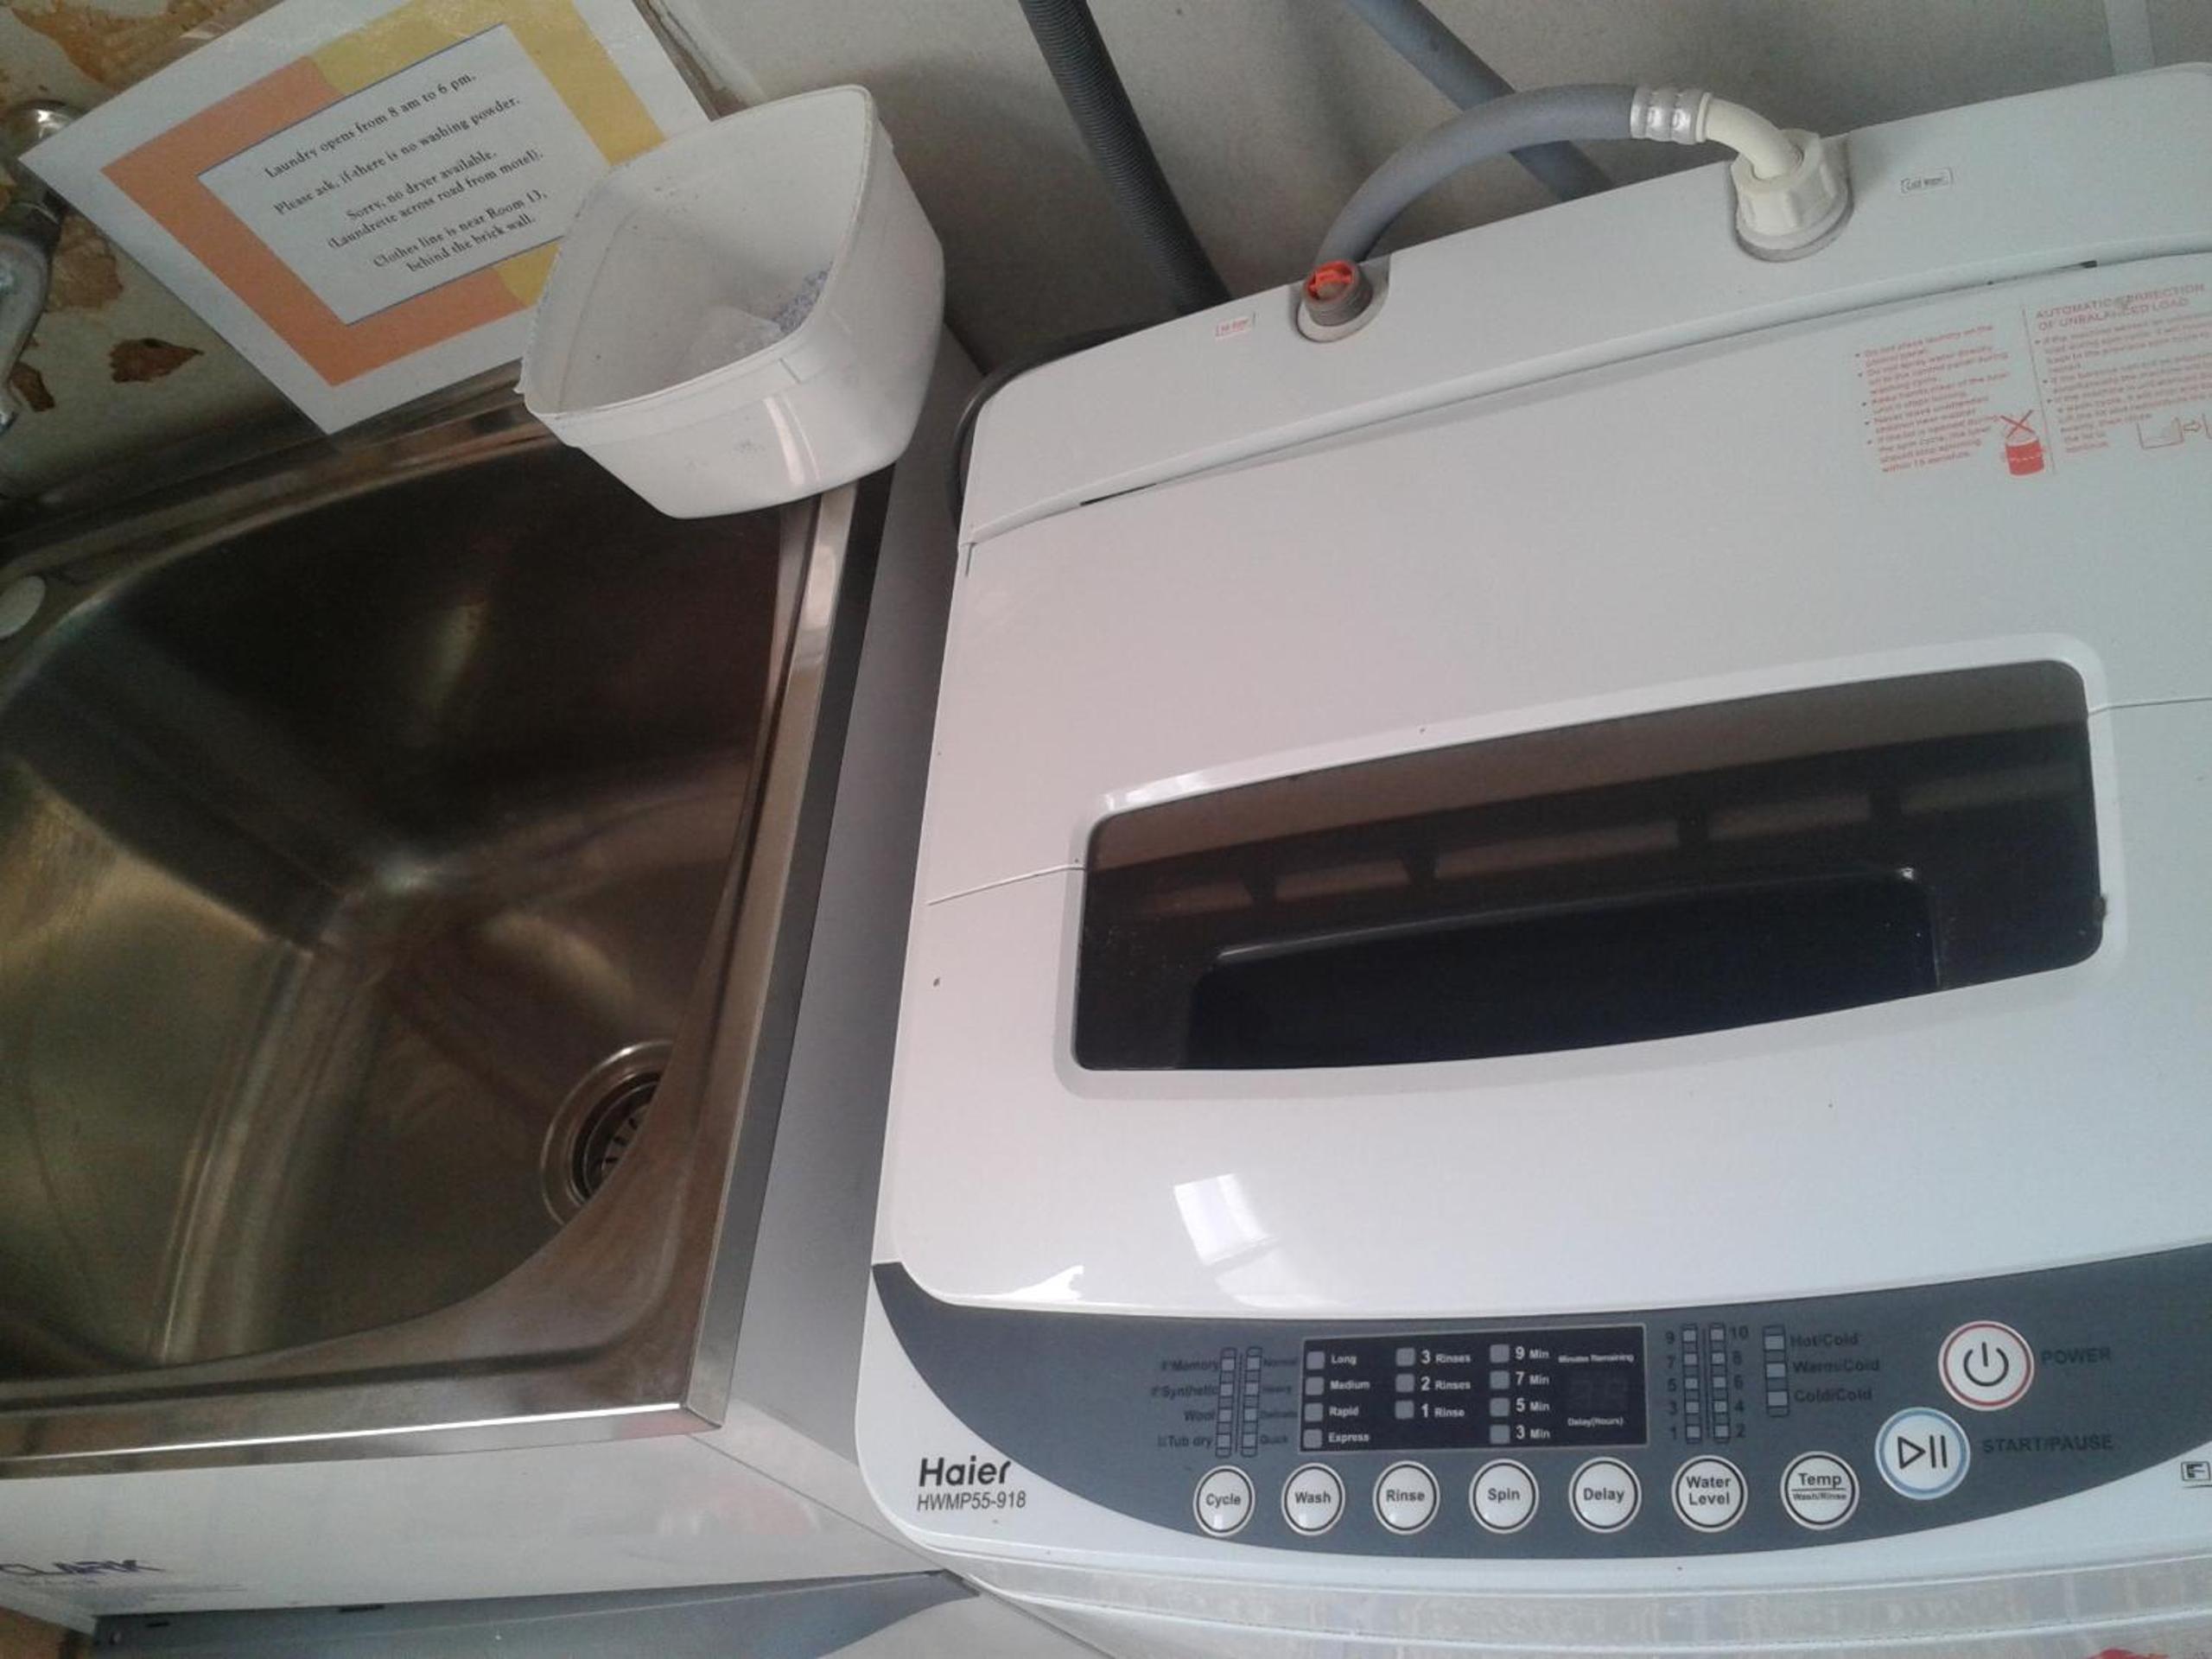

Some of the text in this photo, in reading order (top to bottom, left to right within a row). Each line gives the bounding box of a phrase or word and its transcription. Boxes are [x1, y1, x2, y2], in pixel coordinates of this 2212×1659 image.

[264, 73, 476, 178] Laundry opens from 8 am to 6 pm.
[273, 192, 314, 215] Please
[352, 158, 386, 177] there
[385, 149, 398, 162] is
[400, 143, 417, 155] no
[418, 119, 470, 146] washing
[470, 98, 520, 125] powder.
[346, 149, 497, 219] Sorry, no dryer available.
[399, 197, 435, 217] across
[437, 181, 465, 200] road
[465, 170, 498, 188] from
[372, 245, 418, 267] Clothes
[417, 233, 444, 247] line
[443, 226, 457, 237] is
[459, 215, 485, 232] near
[486, 200, 525, 219] Room
[406, 246, 450, 272] behind
[451, 241, 473, 253] the
[471, 225, 505, 244] brick
[2036, 298, 2113, 319] AUTOMATIC
[1666, 1331, 1675, 1344] 9
[1732, 1325, 1749, 1339] 10
[1331, 1354, 1357, 1365] Long
[1421, 1350, 1471, 1364] 3 Rinses
[1515, 1346, 1549, 1359] 9 Min
[2041, 1347, 2111, 1364] POWER
[1667, 1356, 1675, 1369] 7
[1421, 1376, 1471, 1391] 2 Rinses
[1516, 1371, 1549, 1384] 7 Min
[1330, 1380, 1370, 1390] Medium
[1421, 1404, 1465, 1418] 1 Rinse
[1516, 1398, 1550, 1412] 5 Min
[1734, 1400, 1744, 1413] 4
[1329, 1406, 1359, 1419] Rapid
[1516, 1425, 1550, 1440] 3 Min
[1736, 1425, 1745, 1438] 2
[1328, 1433, 1370, 1445] Express
[1982, 1433, 2114, 1453] START/PAUSE
[918, 1455, 1011, 1487] Haier
[1686, 1476, 1732, 1489] Water
[1798, 1472, 1842, 1488] Temp
[917, 1491, 1027, 1512] HWMP55-918
[1205, 1493, 1241, 1509] Cycle
[1295, 1491, 1332, 1503] Wash
[1386, 1489, 1425, 1503] Rinse
[1487, 1488, 1521, 1503] Spin
[1583, 1487, 1624, 1503] Delay
[1688, 1492, 1730, 1505] Level
[1792, 1491, 1847, 1501] Wash/Rinse
